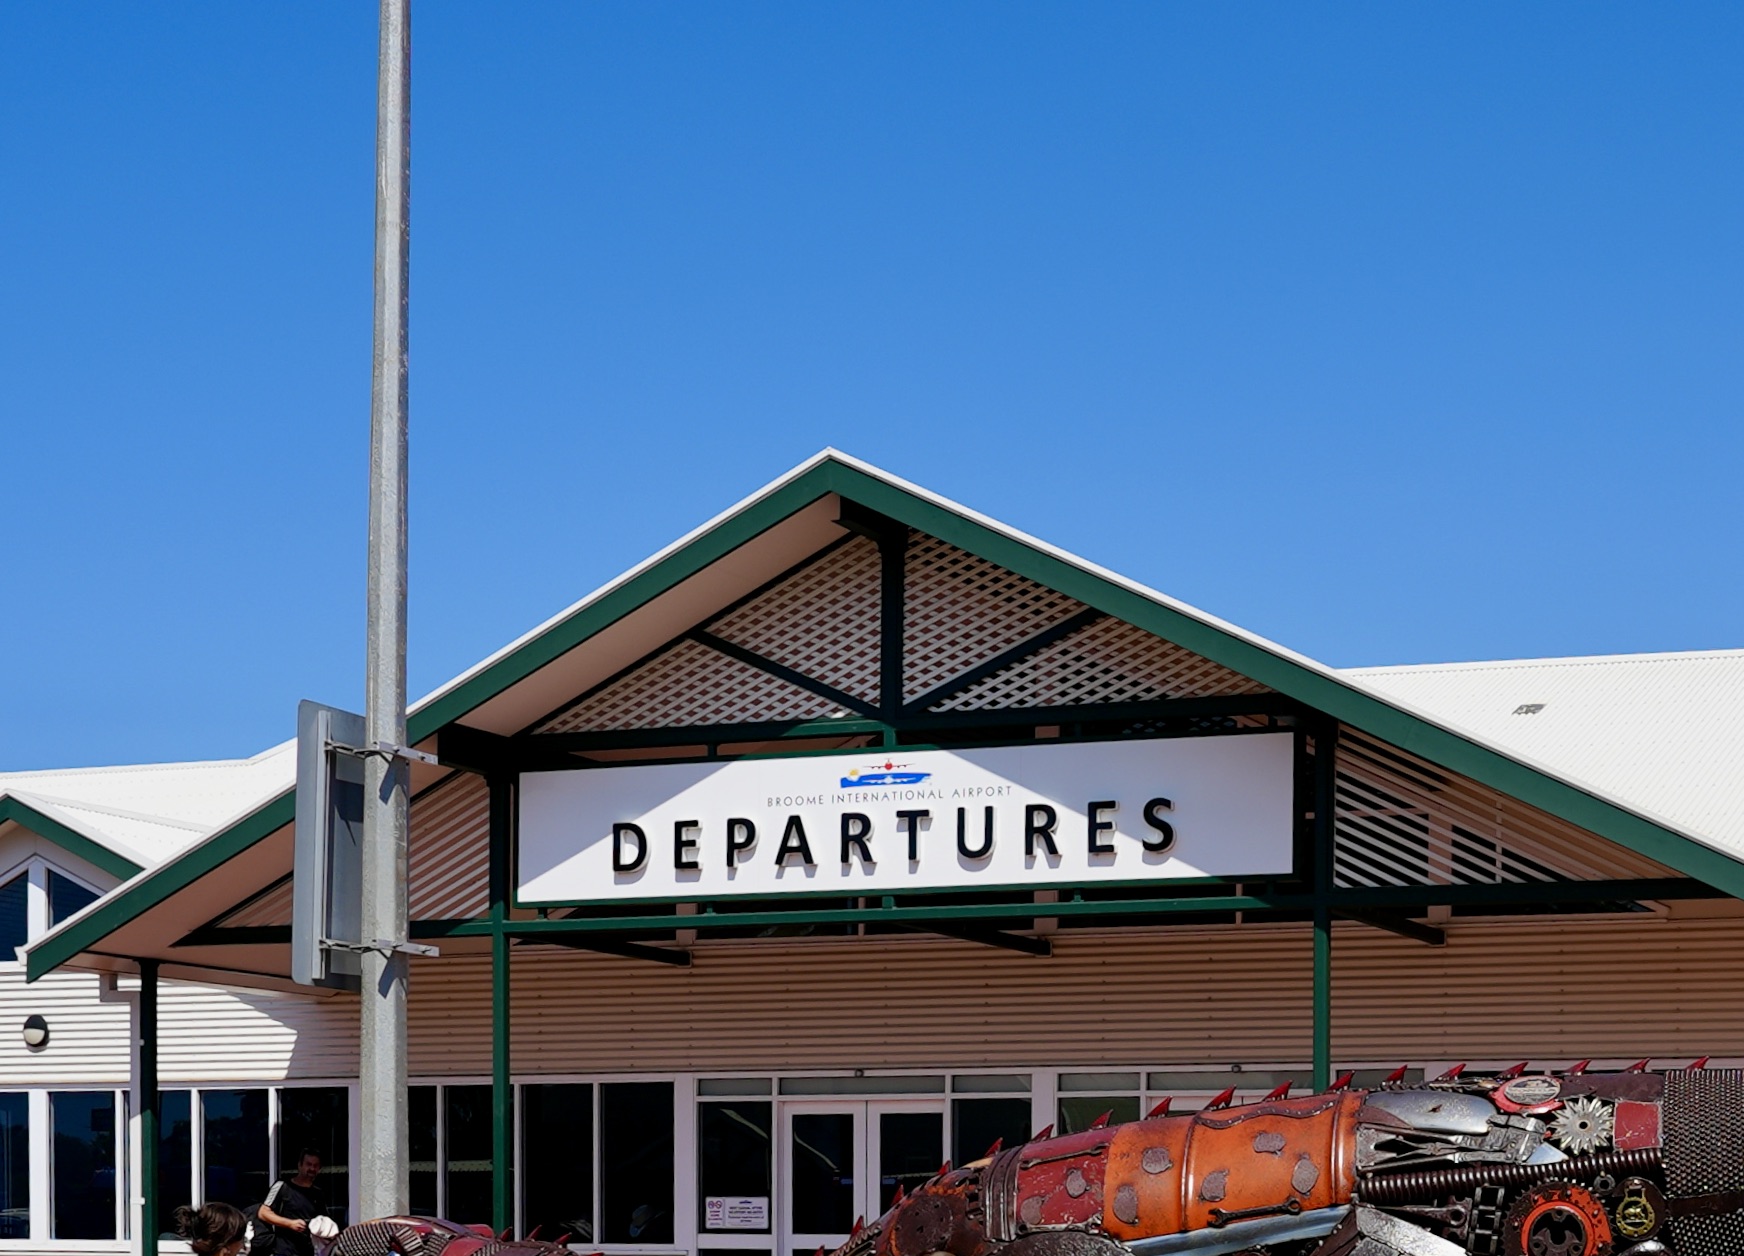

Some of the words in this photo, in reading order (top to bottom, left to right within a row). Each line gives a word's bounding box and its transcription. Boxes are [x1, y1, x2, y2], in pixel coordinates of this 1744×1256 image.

[767, 794, 825, 807] BROOME
[831, 789, 944, 804] INTERNATIONAL
[951, 785, 1012, 798] AIRPORT
[612, 797, 1176, 873] DEPARTURES
